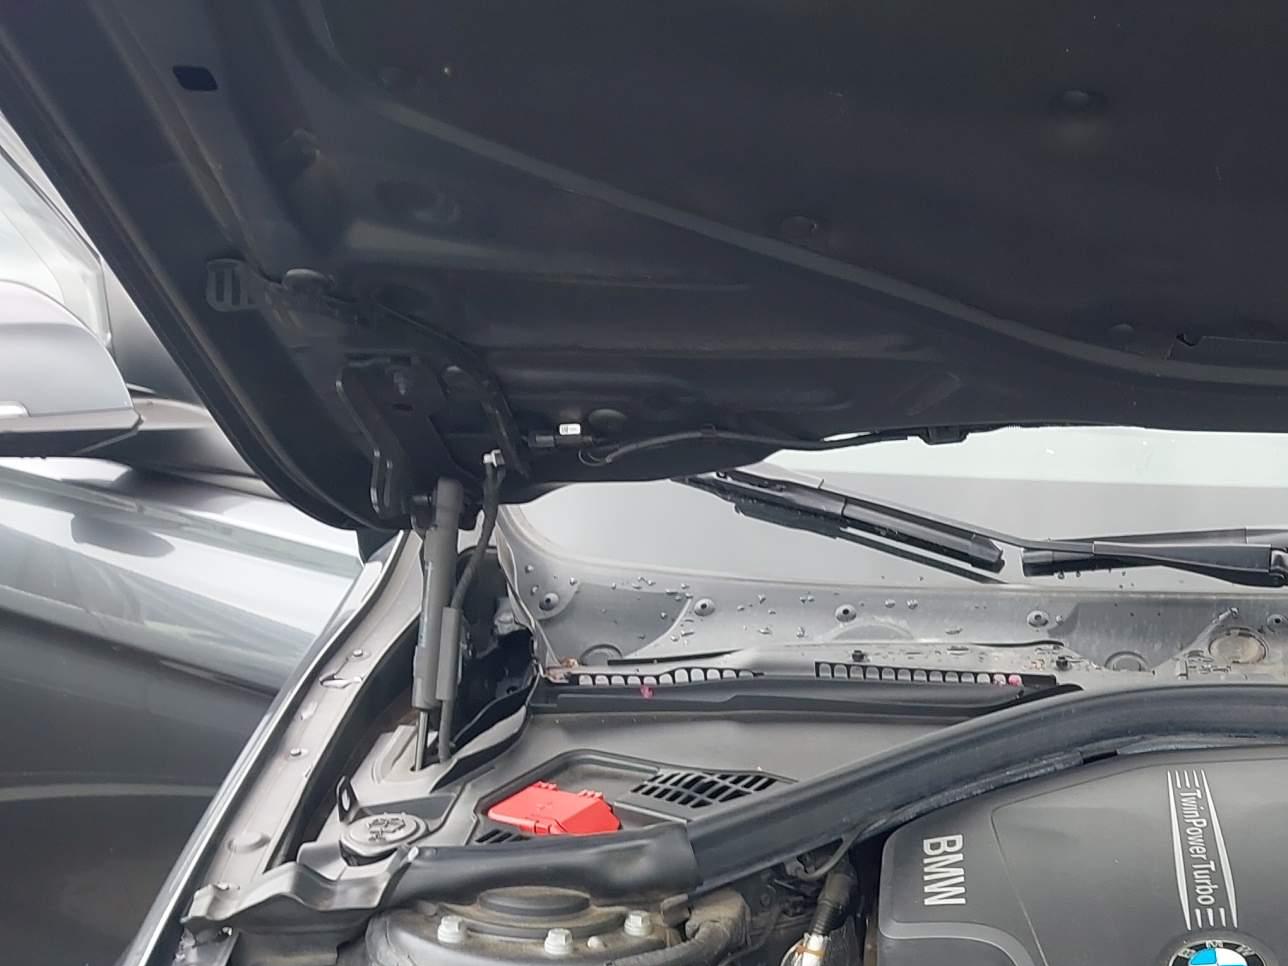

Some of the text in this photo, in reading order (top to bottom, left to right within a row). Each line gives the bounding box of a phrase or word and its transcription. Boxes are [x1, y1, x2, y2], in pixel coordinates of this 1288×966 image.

[923, 833, 966, 906] BMW
[1180, 789, 1219, 905] TwinPower Turbo
